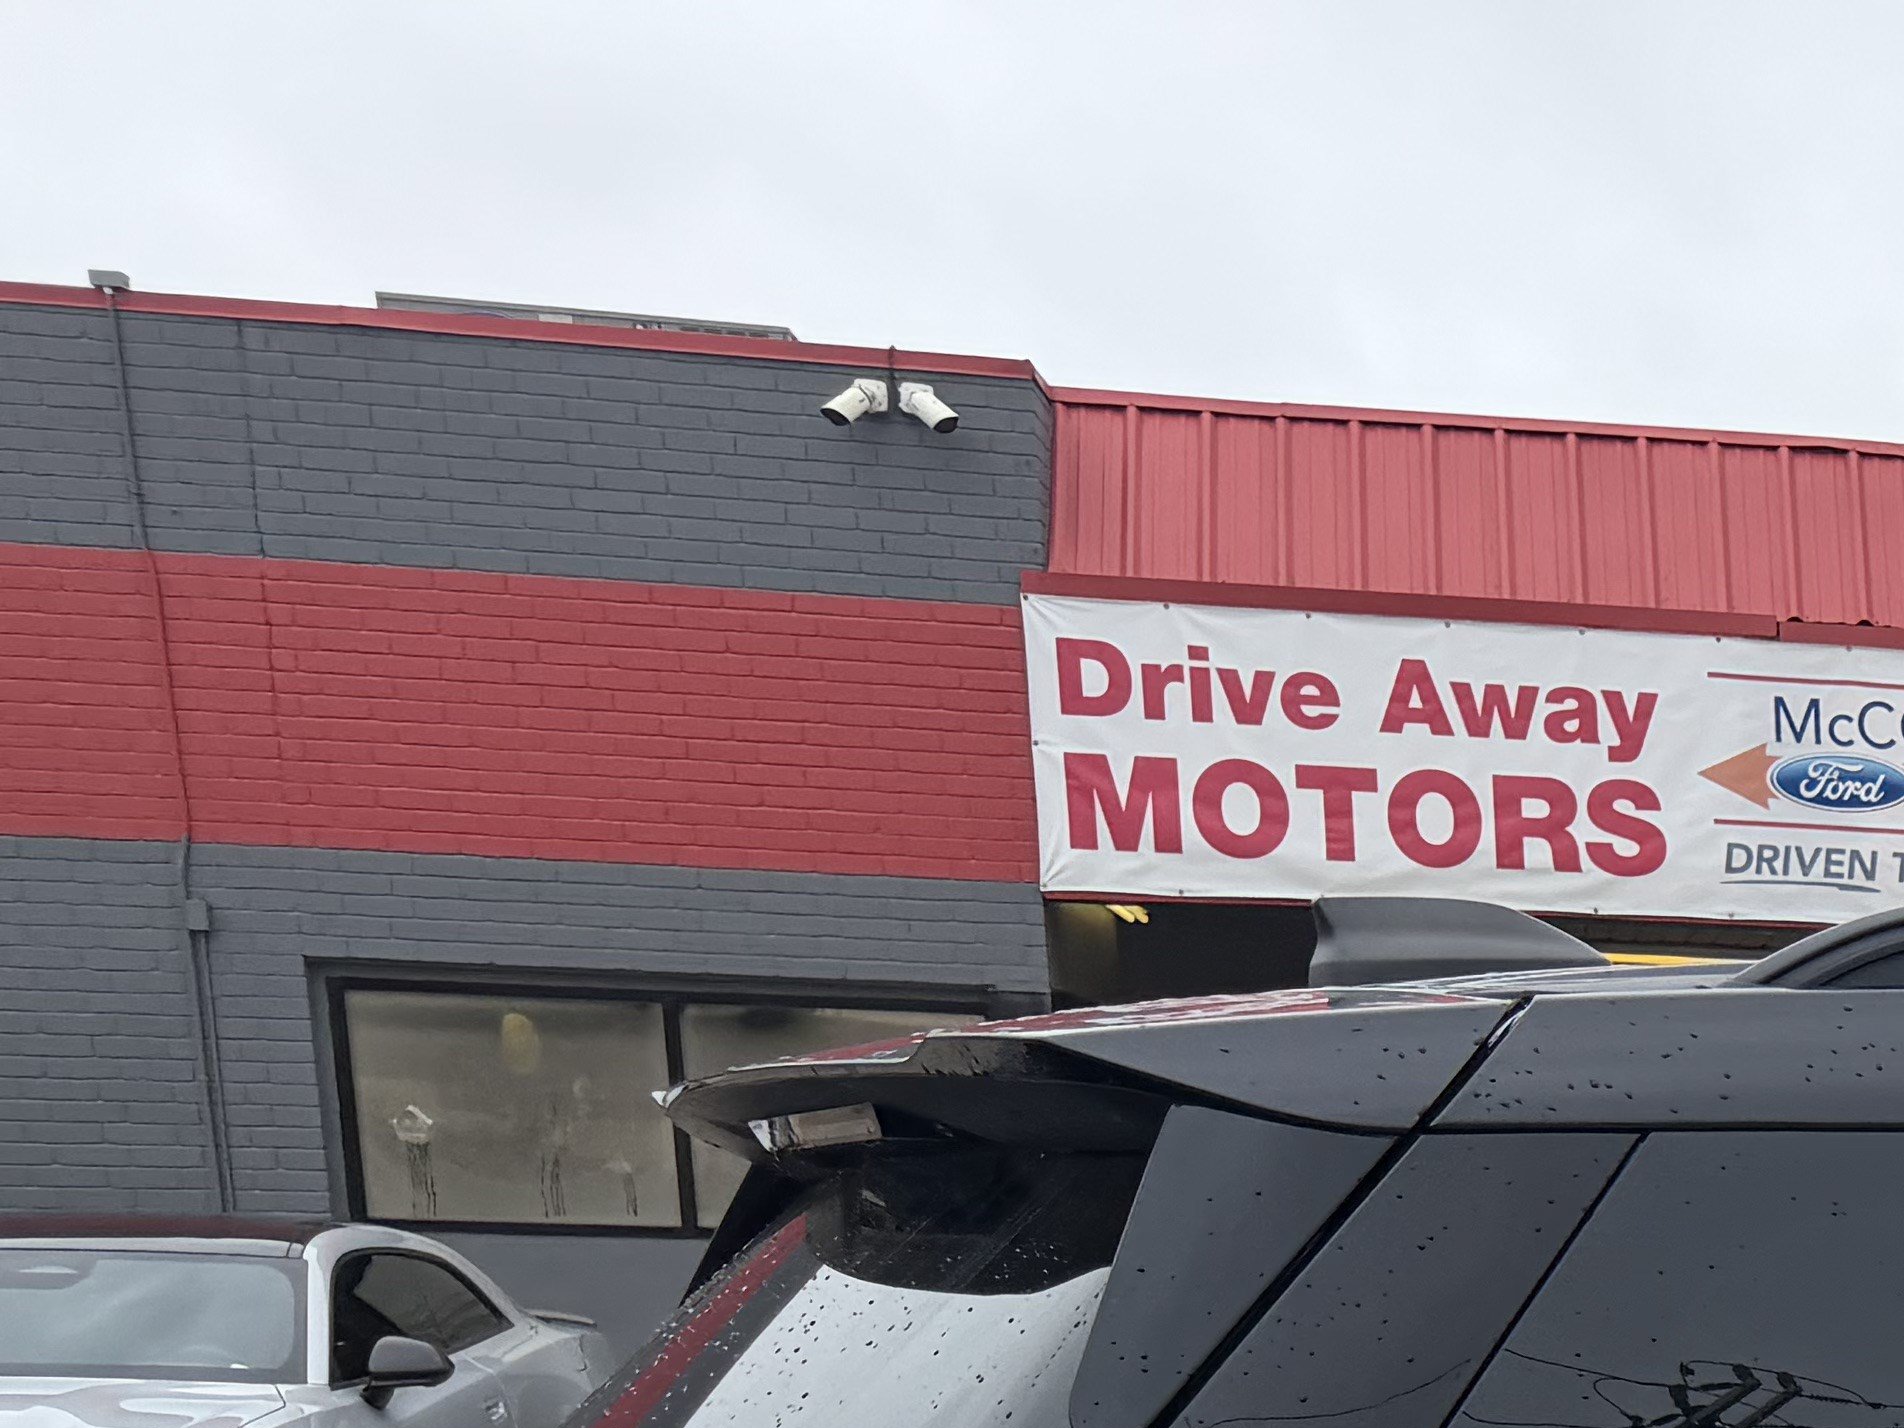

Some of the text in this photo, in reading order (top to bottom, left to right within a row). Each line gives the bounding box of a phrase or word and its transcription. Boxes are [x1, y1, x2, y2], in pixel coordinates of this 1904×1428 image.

[1055, 636, 1660, 764] Drive Away
[1063, 751, 1669, 878] MOTORS
[1799, 759, 1886, 804] Ford
[1724, 841, 1880, 882] DRIVEN
